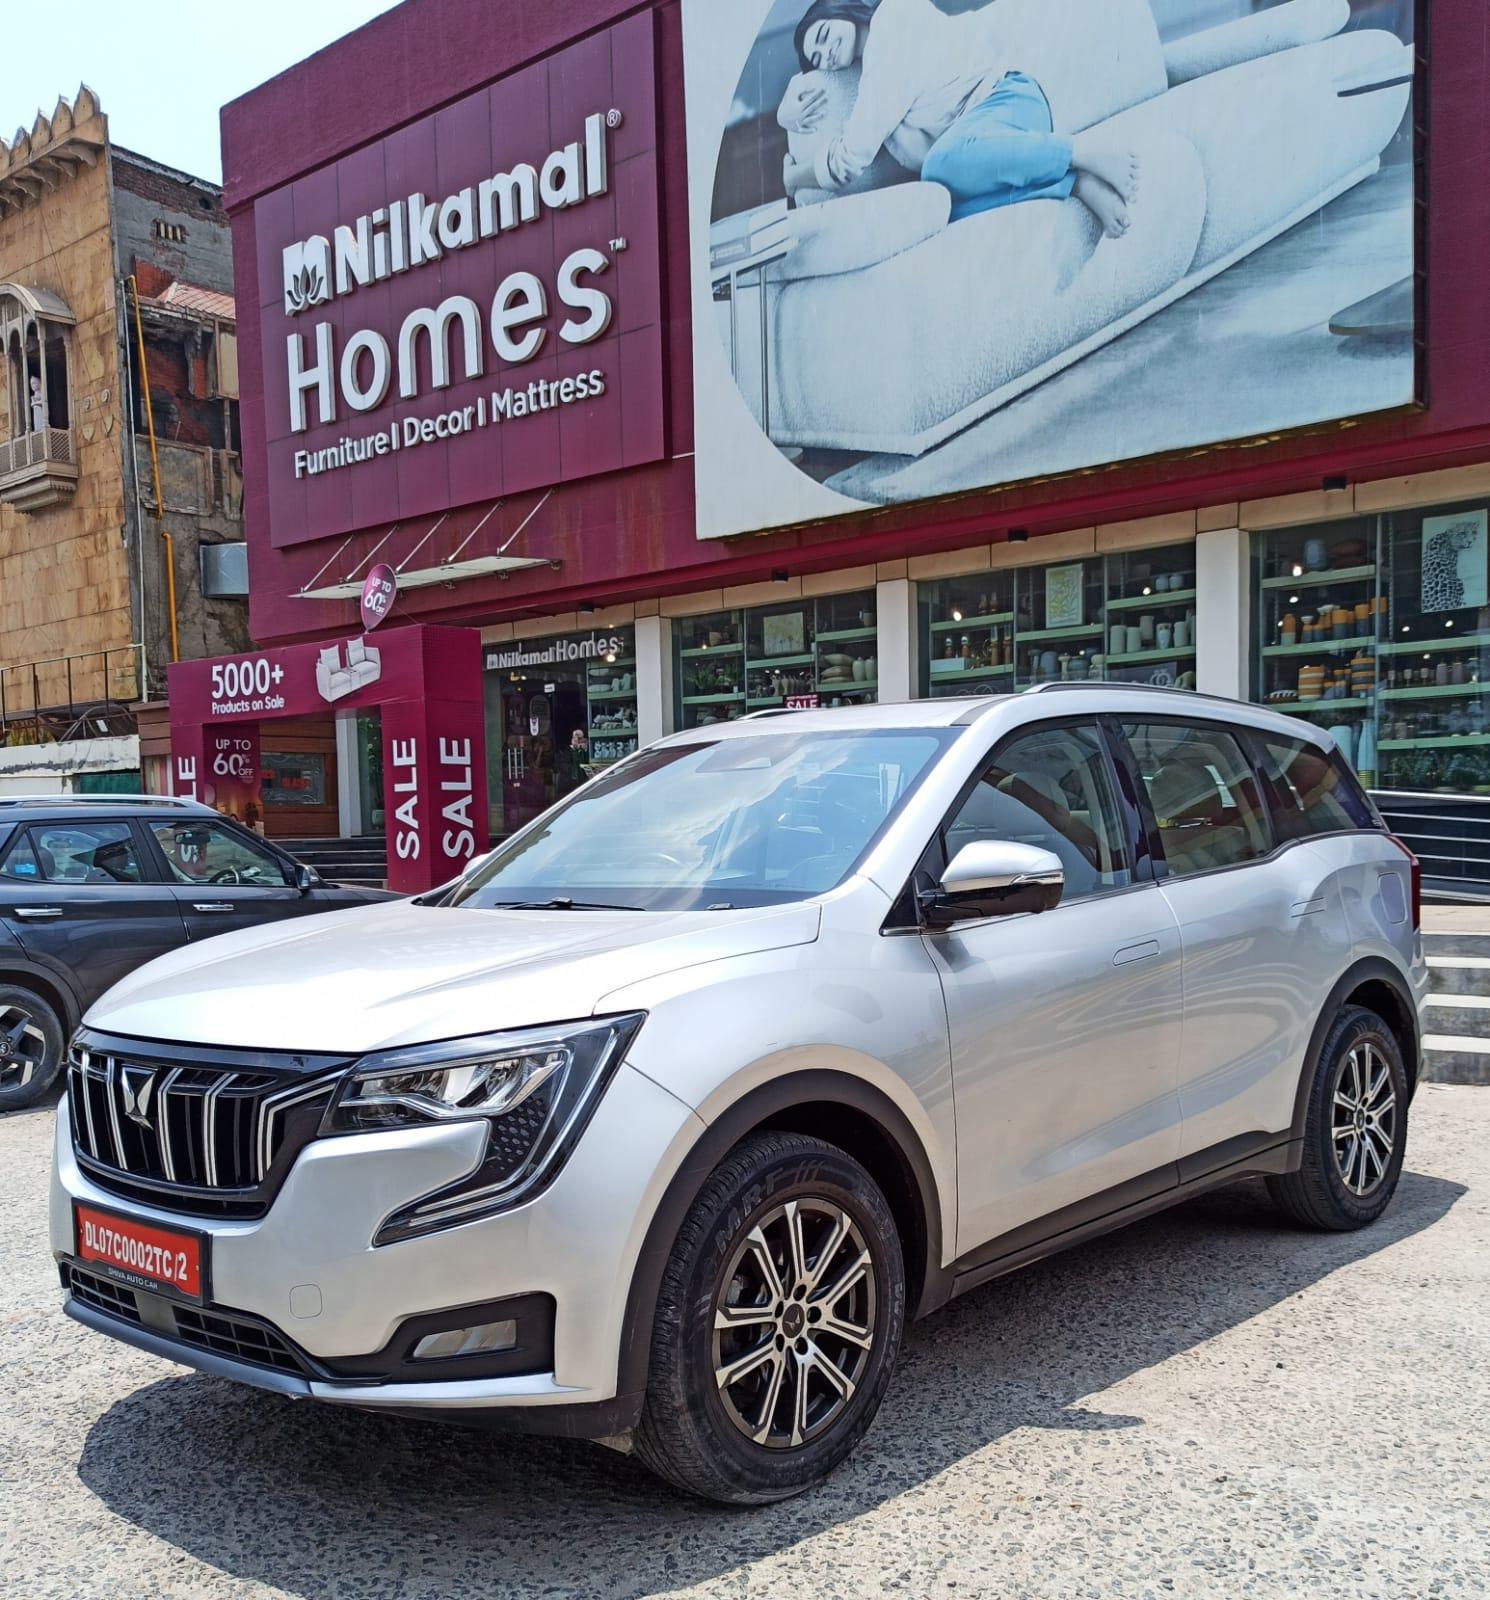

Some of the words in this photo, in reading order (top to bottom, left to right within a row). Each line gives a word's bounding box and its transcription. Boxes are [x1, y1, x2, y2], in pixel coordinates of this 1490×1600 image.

[334, 113, 607, 295] Nilkamal
[286, 248, 612, 432] Homes
[295, 432, 390, 479] Furniture
[403, 405, 475, 447] Decor
[492, 369, 605, 423] Mattress
[211, 658, 284, 699] 5000+
[500, 646, 555, 668] Nilkamal
[556, 636, 619, 662] Homes
[211, 700, 250, 715] Products
[251, 699, 264, 711] on
[264, 694, 285, 710] Sale
[215, 738, 230, 750] UP
[233, 739, 252, 751] TO
[392, 738, 420, 860] SALE
[439, 737, 475, 859] SALE
[126, 1273, 144, 1286] AUTO
